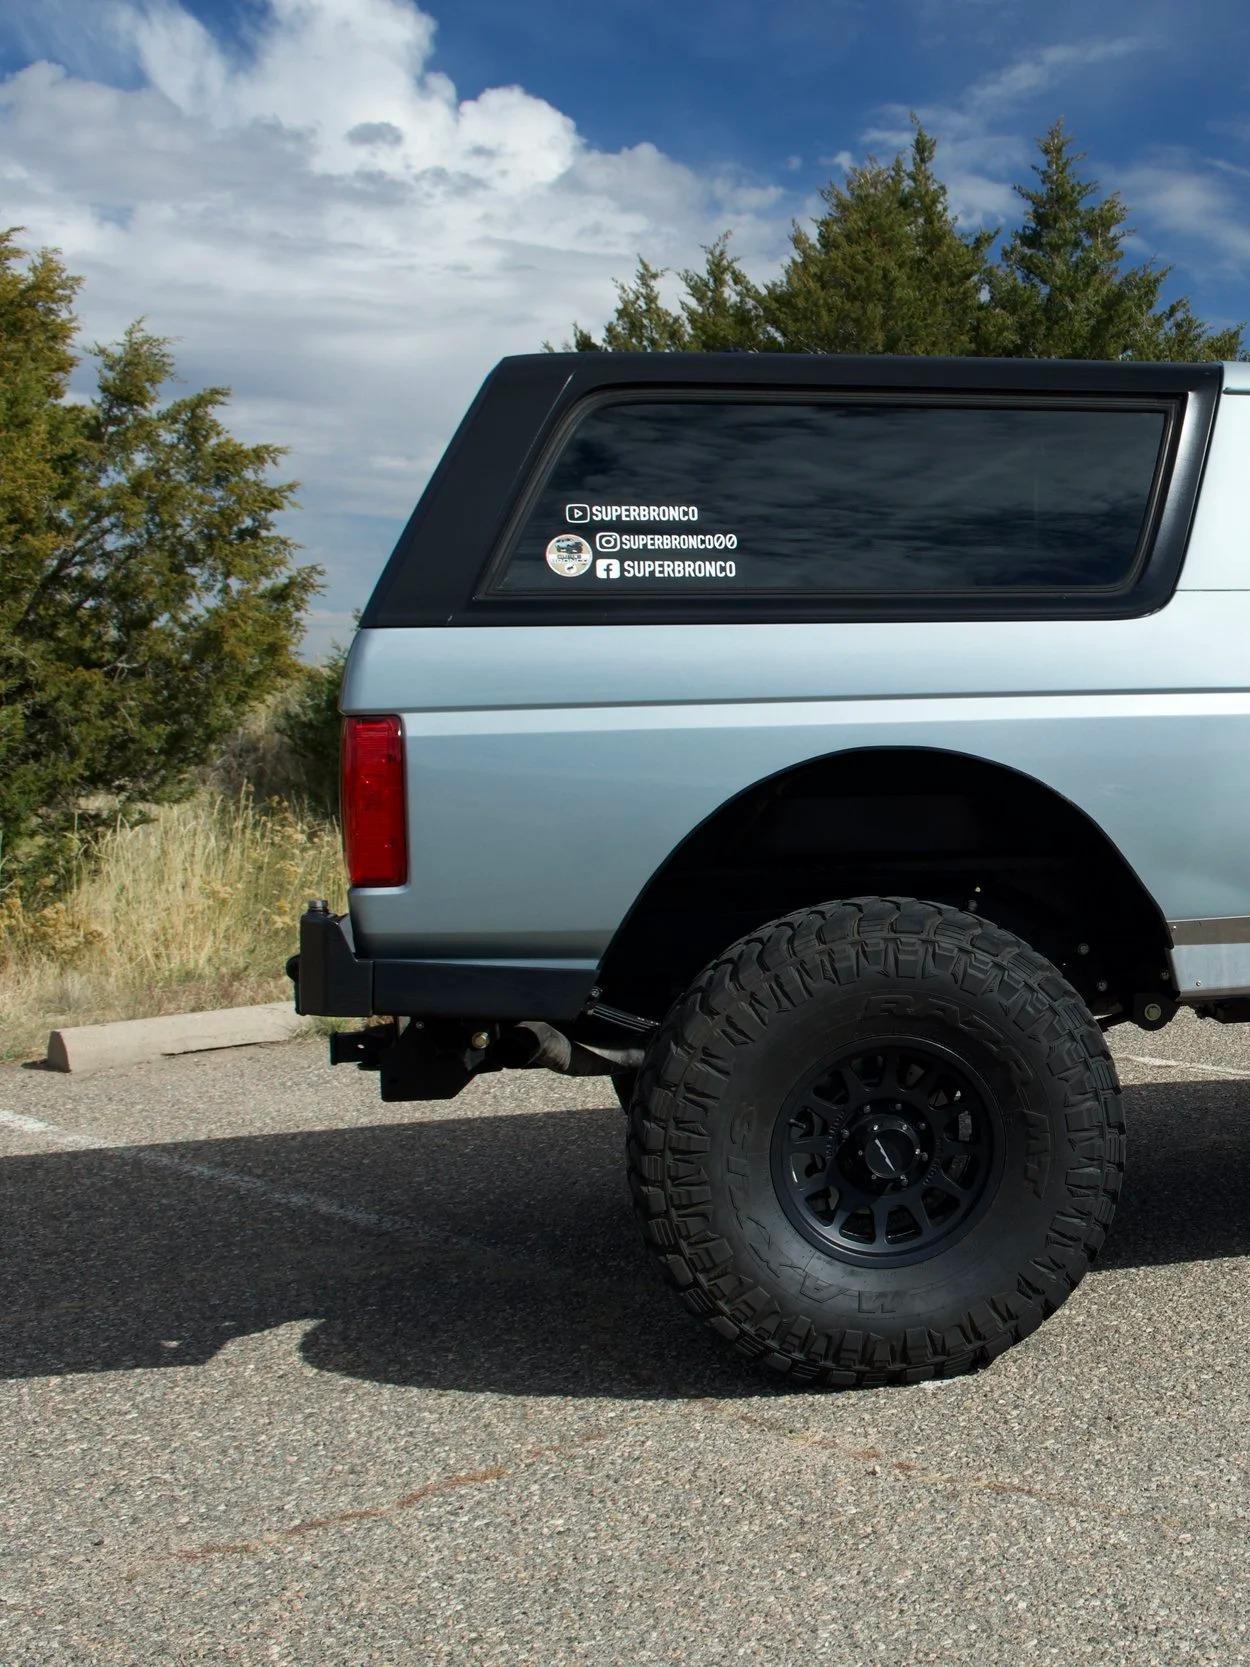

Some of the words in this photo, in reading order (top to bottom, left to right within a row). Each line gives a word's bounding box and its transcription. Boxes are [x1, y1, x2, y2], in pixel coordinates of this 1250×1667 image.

[592, 506, 698, 521] SUPERBRONCO
[622, 533, 738, 549] SUPERBRONCO00
[624, 560, 736, 578] SUPERBRONCO
